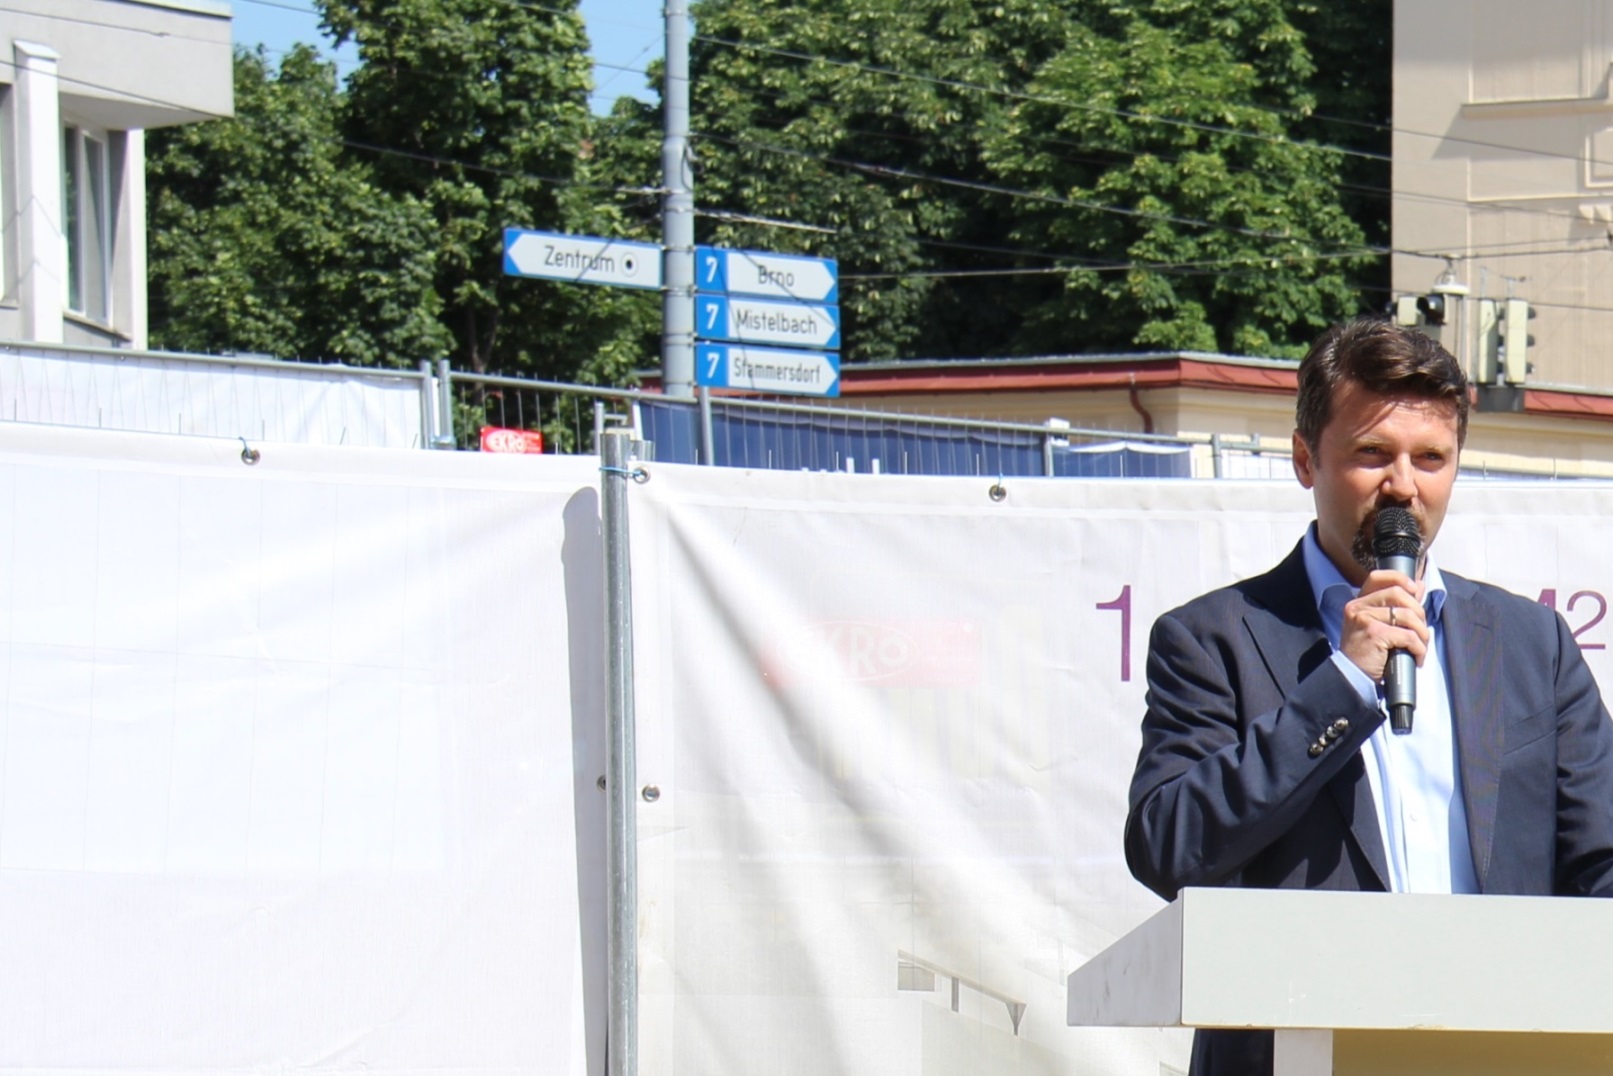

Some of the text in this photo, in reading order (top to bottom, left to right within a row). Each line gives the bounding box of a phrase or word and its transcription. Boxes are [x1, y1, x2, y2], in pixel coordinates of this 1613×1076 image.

[543, 245, 615, 274] Zentrum
[706, 256, 795, 288] 7 Brno
[706, 303, 818, 336] 7 Mistelbach
[707, 352, 821, 384] 7 Stammersdorf
